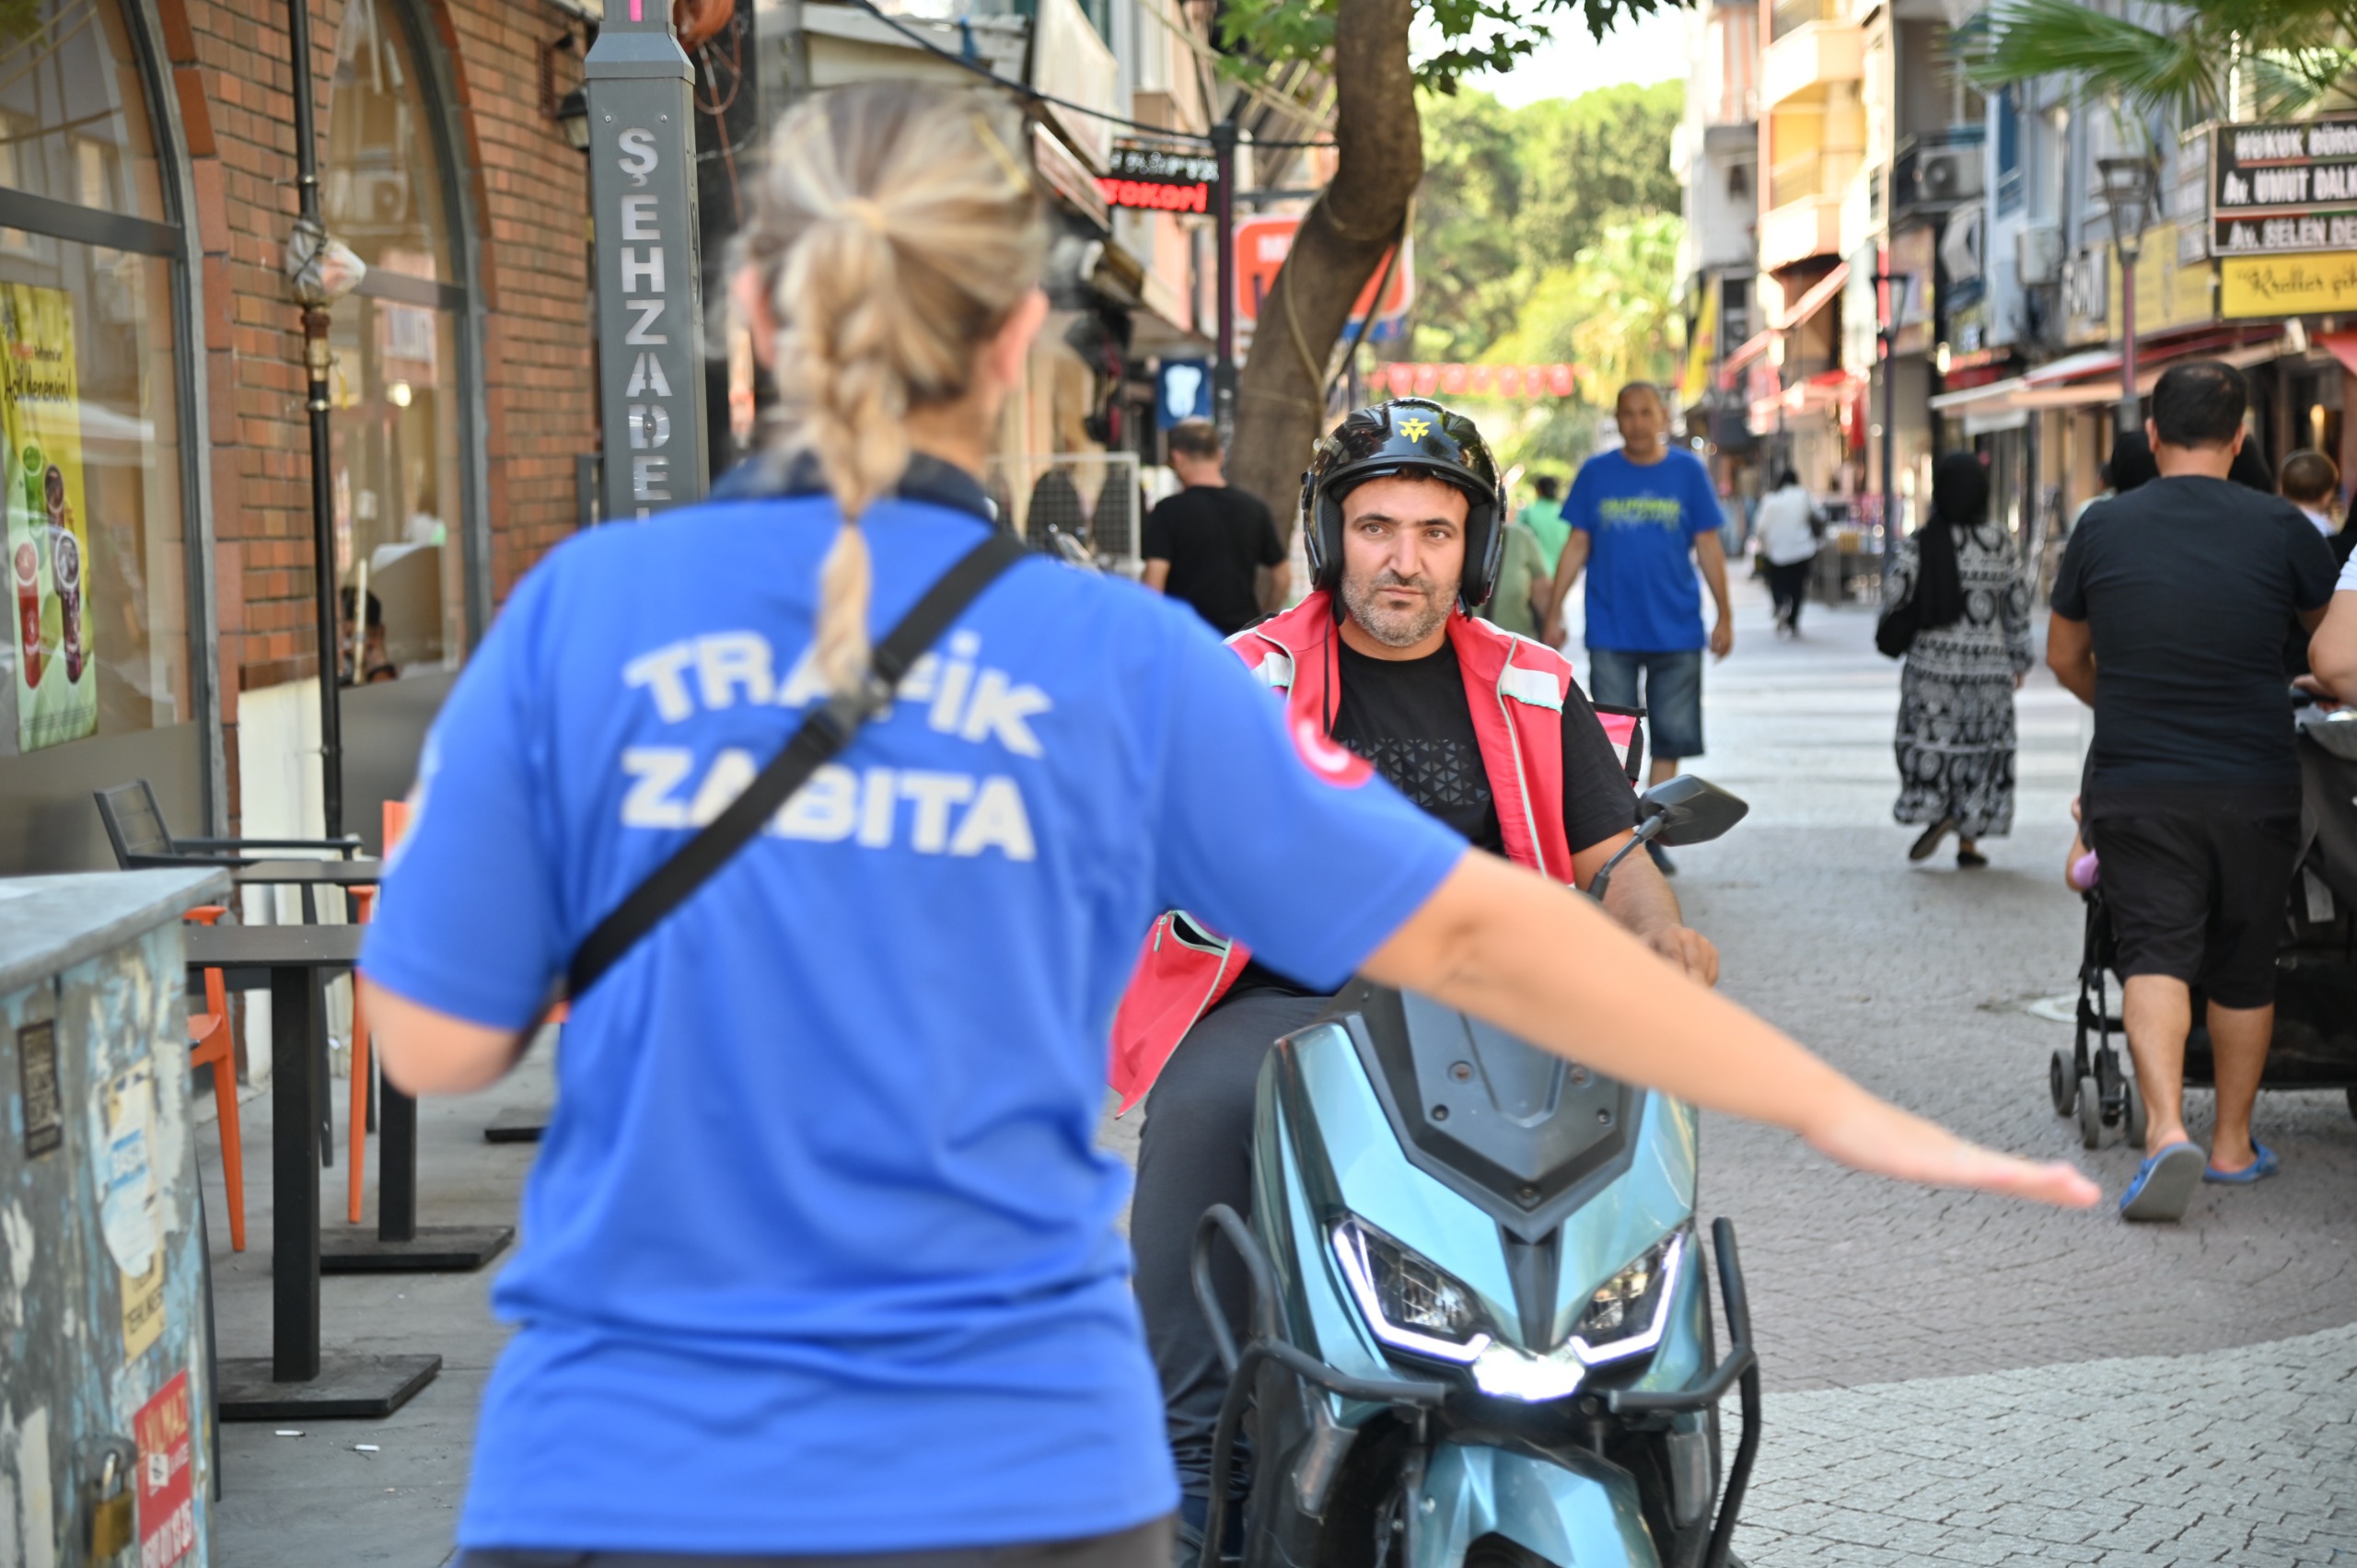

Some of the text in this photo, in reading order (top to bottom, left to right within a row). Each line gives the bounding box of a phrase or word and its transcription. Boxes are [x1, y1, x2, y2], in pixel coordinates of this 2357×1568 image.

[2253, 168, 2309, 203] UMUT
[2261, 217, 2327, 249] SELEN
[618, 127, 673, 523] ŞEHZADE
